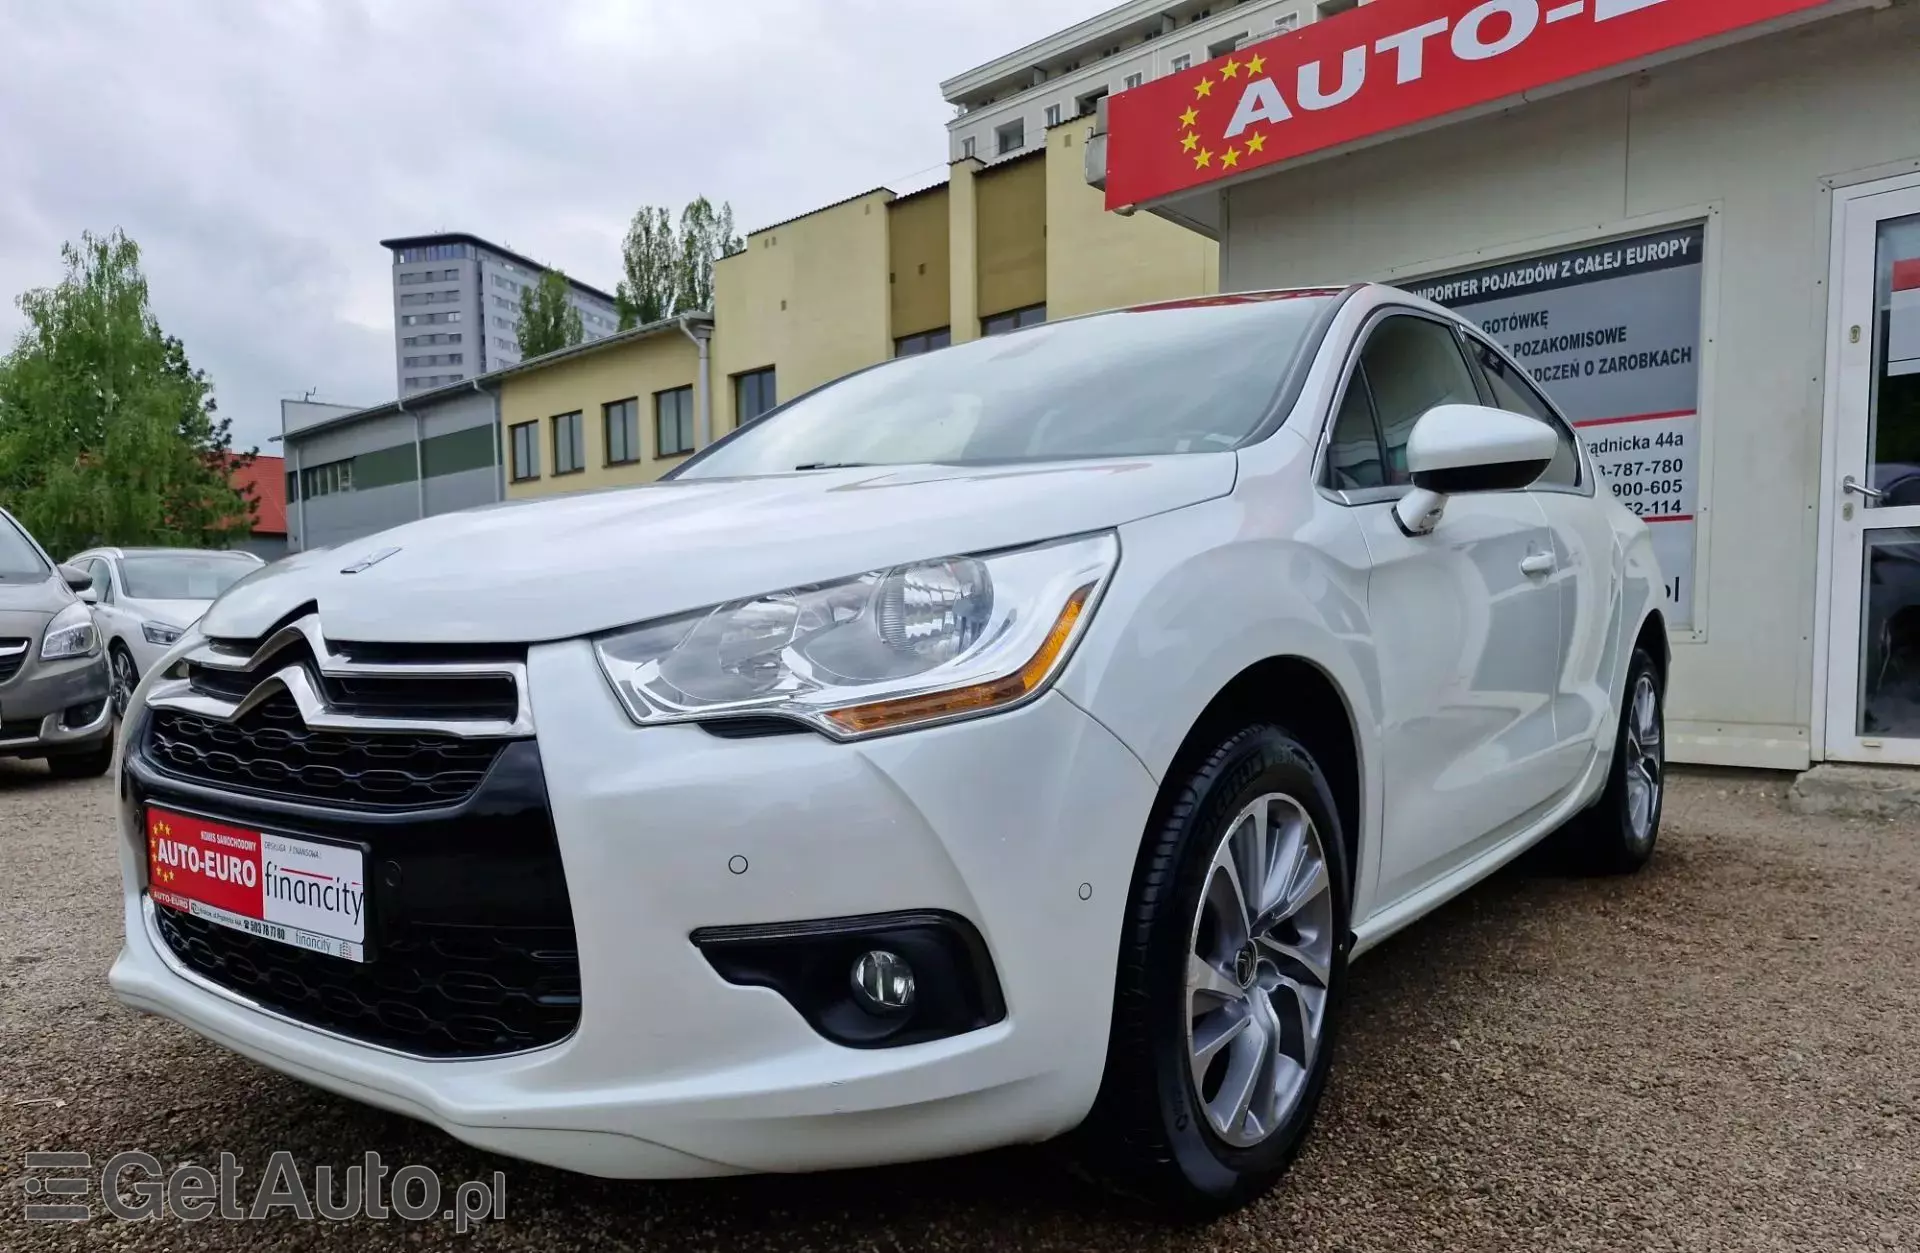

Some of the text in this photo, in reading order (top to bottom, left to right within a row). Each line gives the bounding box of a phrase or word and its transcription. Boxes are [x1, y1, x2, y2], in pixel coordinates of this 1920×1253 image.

[1482, 262, 1557, 293] POJAZDÓW
[1561, 260, 1571, 278] Z
[1575, 251, 1622, 275] CAŁEJ
[1626, 237, 1692, 266] EUROPY
[1482, 309, 1549, 334] GOTÓWKĘ
[1513, 325, 1627, 359] POZAKOMISOWE
[1584, 359, 1595, 377] O
[1599, 346, 1693, 375] ZAROBKACH
[1655, 431, 1684, 448] 44a
[1612, 479, 1683, 497] 900-605
[158, 838, 257, 888] AUTO-EURO
[265, 861, 364, 926] financity
[295, 929, 332, 955] financity
